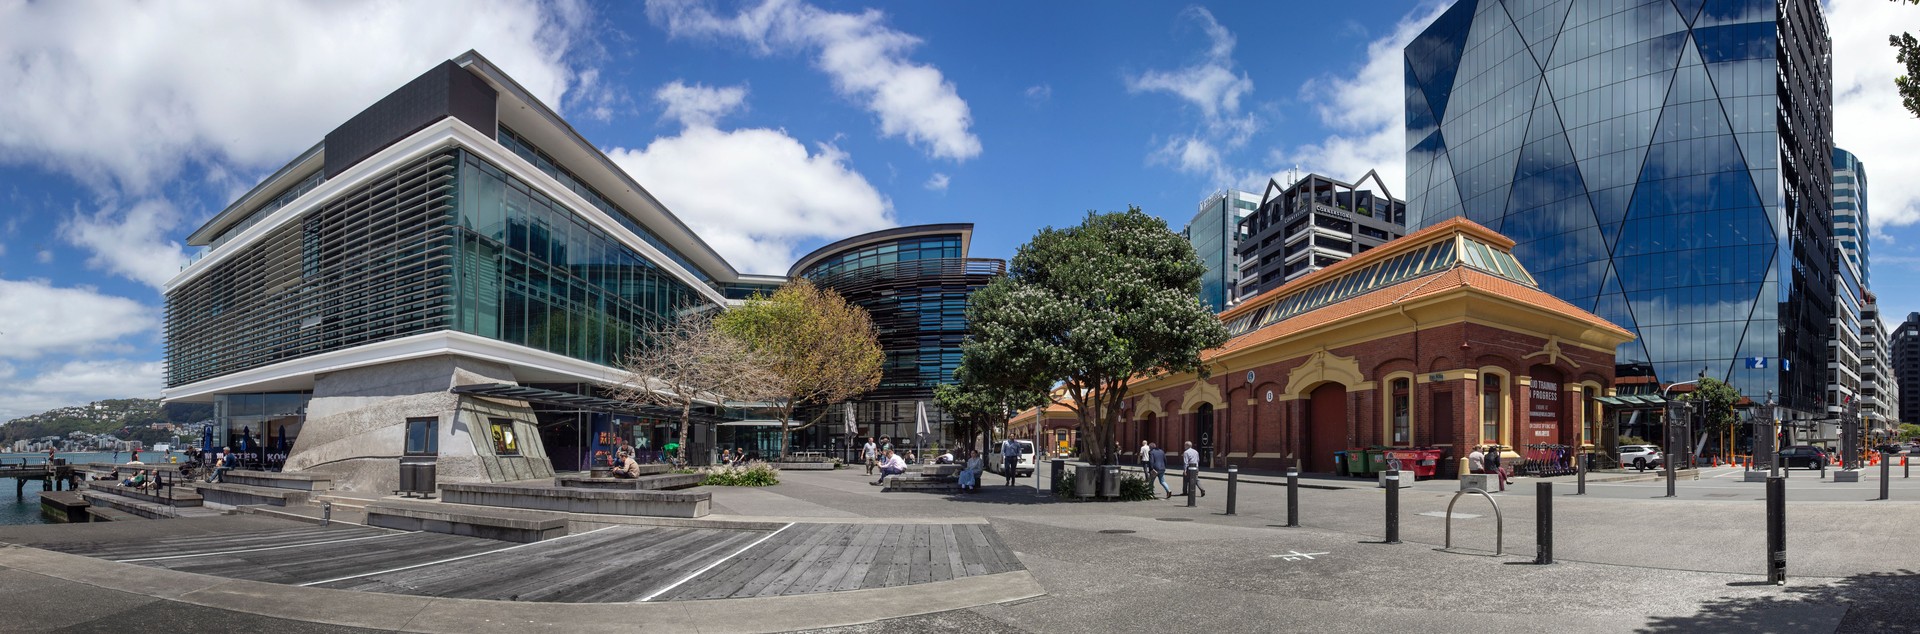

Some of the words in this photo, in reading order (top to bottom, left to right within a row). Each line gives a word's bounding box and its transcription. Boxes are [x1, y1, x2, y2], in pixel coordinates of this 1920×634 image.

[1746, 357, 1768, 369] NZI
[1538, 380, 1557, 391] TRAINING
[1533, 390, 1557, 401] PROGRESS
